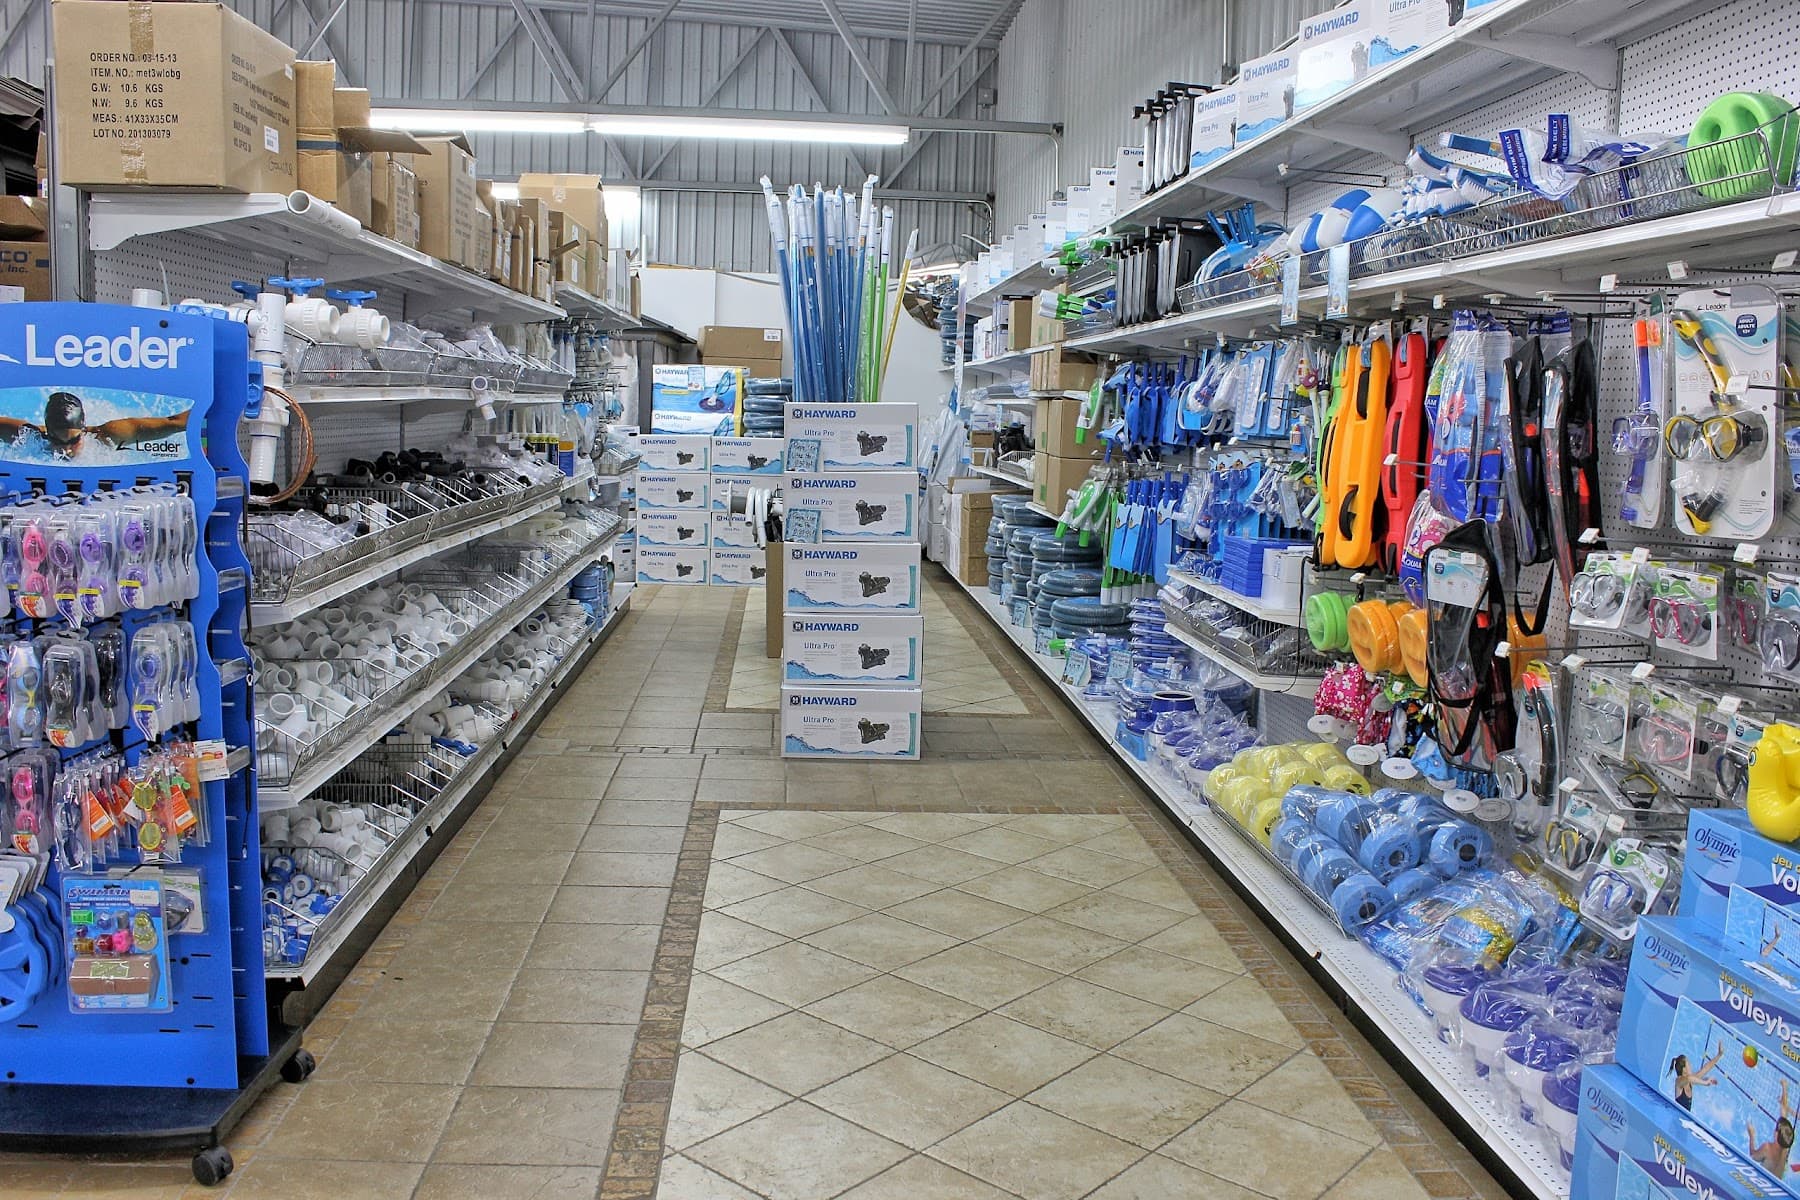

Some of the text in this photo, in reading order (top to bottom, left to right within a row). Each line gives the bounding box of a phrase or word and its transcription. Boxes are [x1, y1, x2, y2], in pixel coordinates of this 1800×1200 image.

[1313, 11, 1359, 36] HAYWARD
[90, 53, 120, 62] ORDER
[142, 54, 177, 63] 03-15-13
[91, 68, 114, 77] ITEM.
[1251, 58, 1290, 79] HAYWARD
[91, 83, 111, 93] G.W:
[145, 84, 164, 93] KGS
[92, 98, 164, 108] N.W: 9.6 KGS
[1204, 94, 1236, 112] HAYWARD
[92, 113, 179, 124] MEAS.: 41X33X35CM
[93, 129, 171, 139] LOT NO. 201303079
[7, 264, 29, 273] Inc.
[1705, 303, 1728, 311] Leader
[25, 324, 188, 369] Leader
[804, 410, 857, 419] HAYWARD
[804, 429, 835, 437] Ultra Pro
[136, 439, 181, 453] Leader
[803, 479, 857, 488] HAYWARD
[802, 498, 833, 506] Ultra Pro
[804, 551, 858, 560] HAYWARD
[805, 623, 859, 632] HAYWARD
[804, 642, 835, 650] Ultra Pro
[802, 697, 857, 706] HAYWARD
[822, 716, 834, 724] Pro
[1694, 828, 1741, 859] Olympic
[1772, 853, 1793, 869] Jeu
[1643, 935, 1690, 971] Olympic
[1719, 971, 1738, 988] Jeu
[1587, 1086, 1628, 1127] Olympic
[1653, 1132, 1688, 1165] Jeu de
